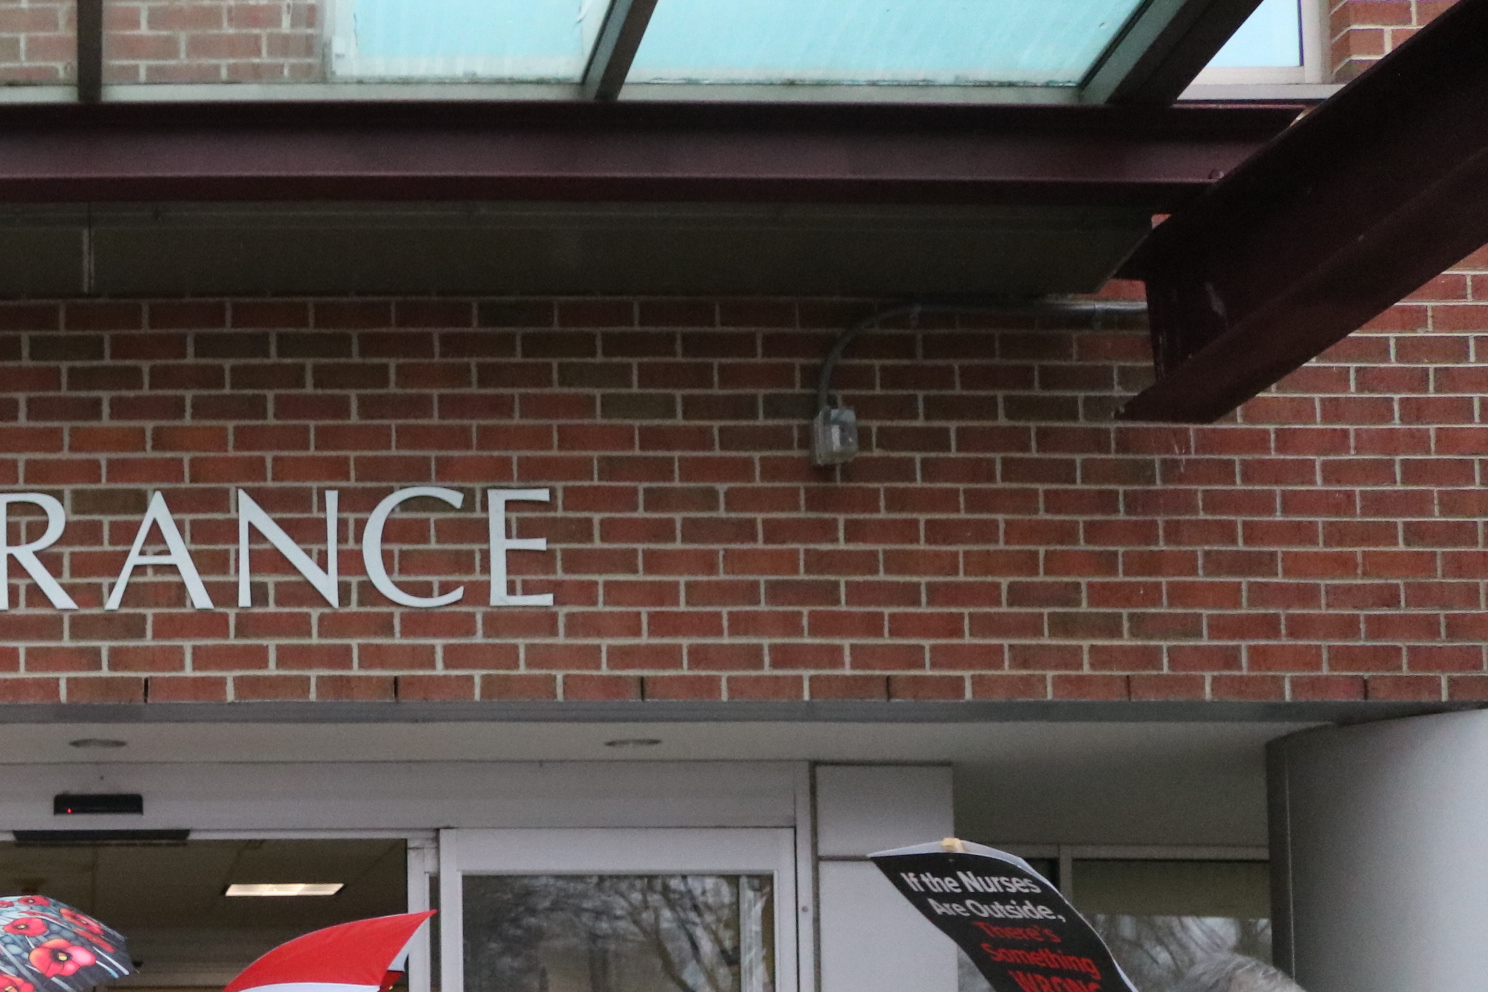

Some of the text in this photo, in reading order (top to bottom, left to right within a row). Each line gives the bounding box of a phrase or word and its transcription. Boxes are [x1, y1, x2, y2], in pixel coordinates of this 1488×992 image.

[900, 870, 1042, 894] If the Nurses
[927, 897, 1067, 923] Are Outside,
[972, 920, 1063, 944] There's
[980, 942, 1103, 981] Something
